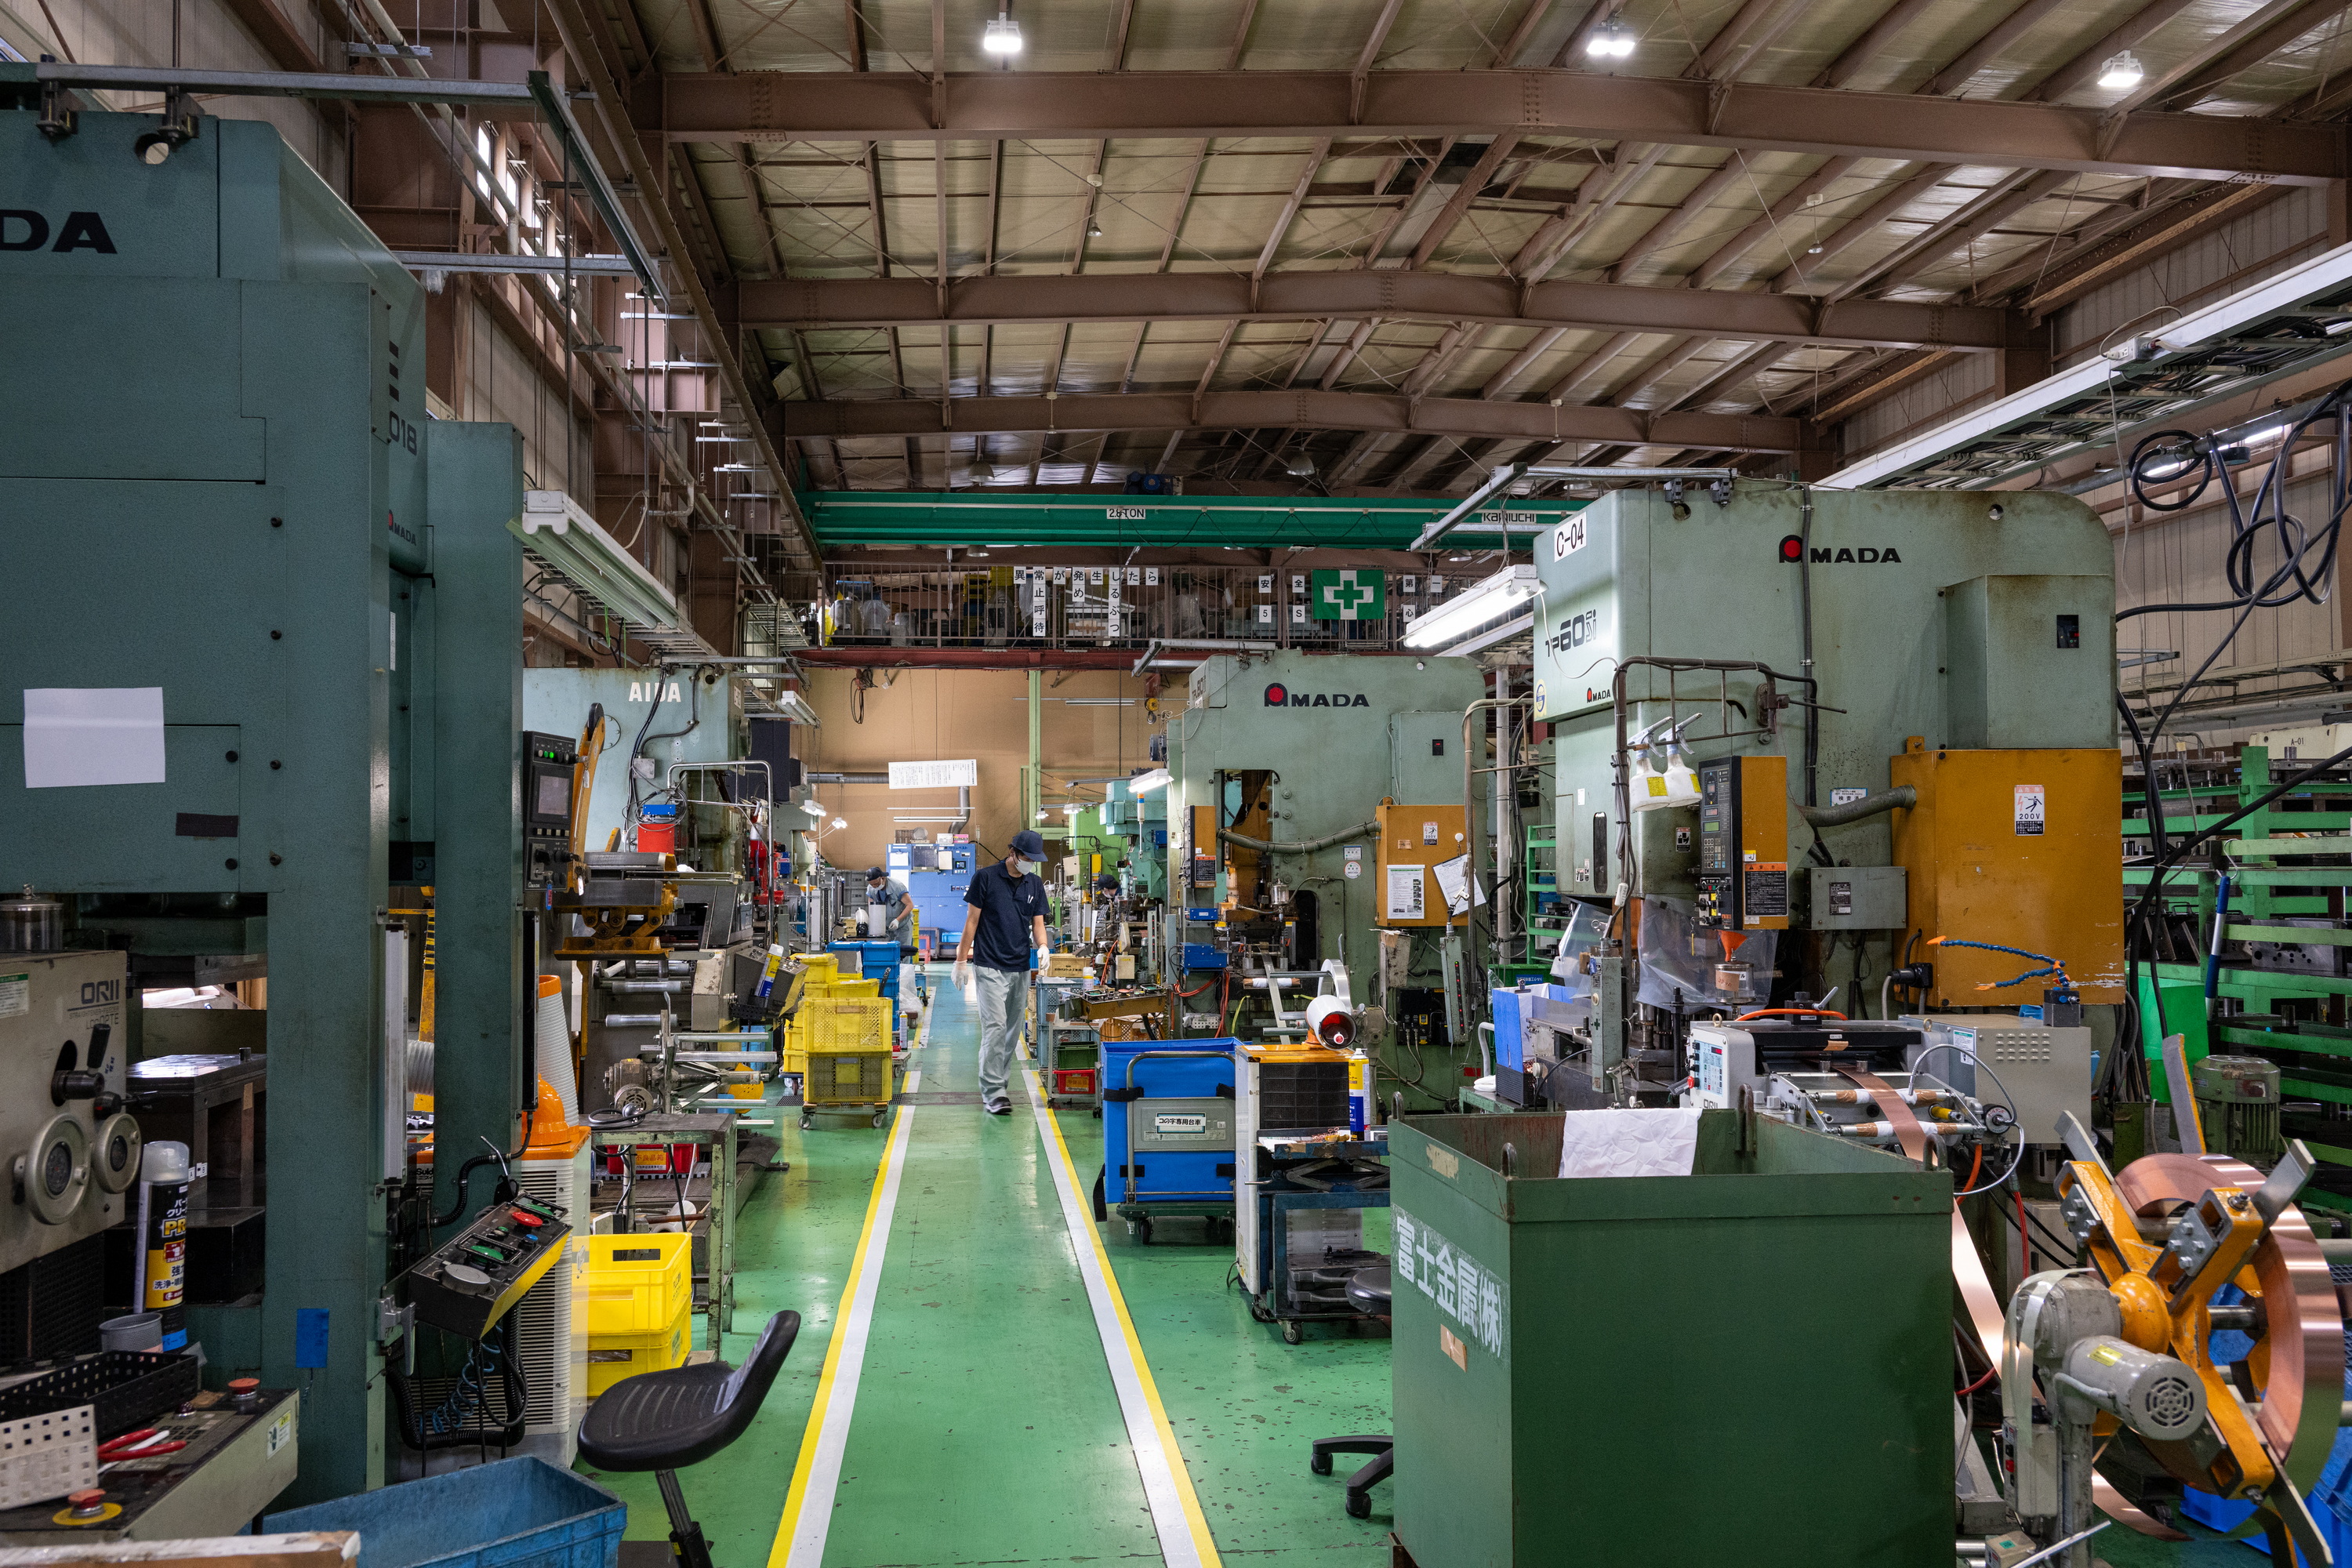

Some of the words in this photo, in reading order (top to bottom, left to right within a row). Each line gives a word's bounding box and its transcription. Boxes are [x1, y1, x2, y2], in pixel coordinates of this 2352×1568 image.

[1556, 518, 1584, 557] C-04
[1779, 535, 1902, 563] AMADA
[1264, 682, 1370, 707] AMADA
[81, 978, 120, 1004] ORII
